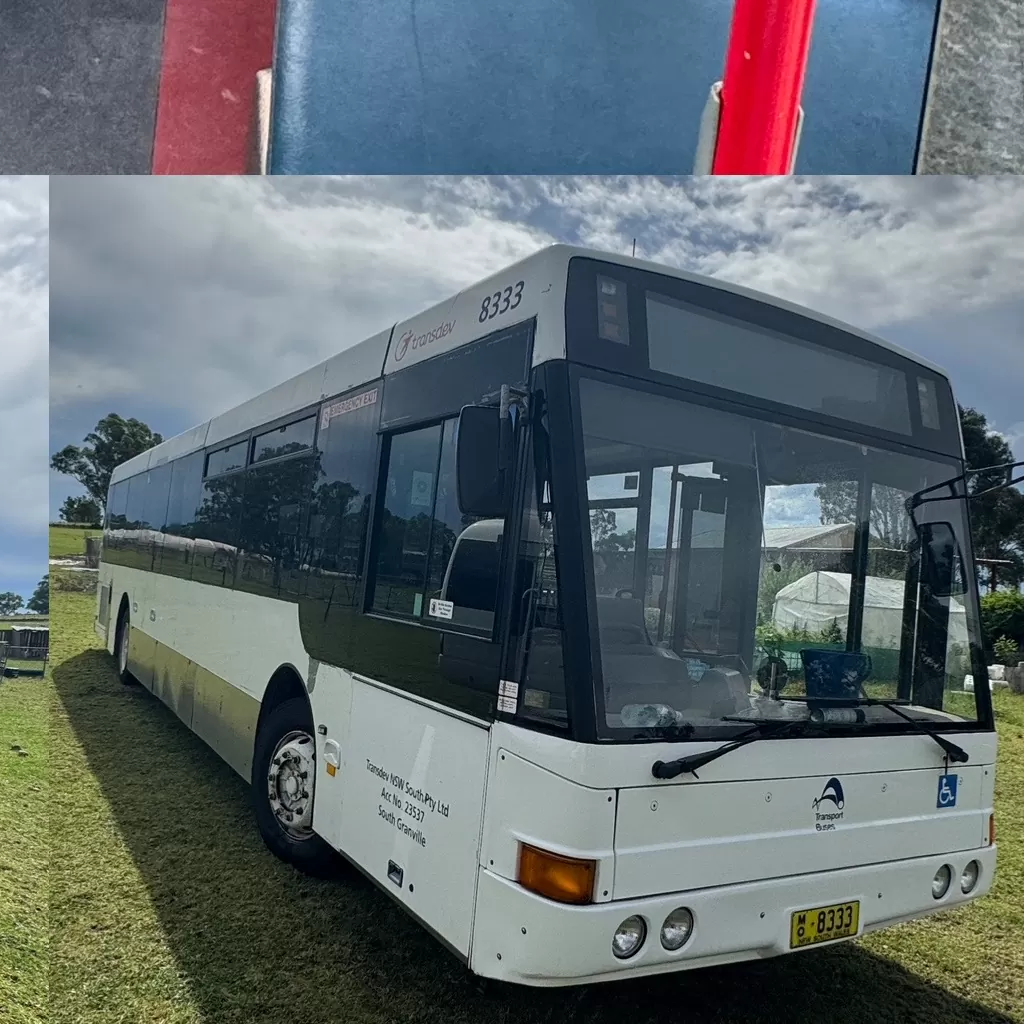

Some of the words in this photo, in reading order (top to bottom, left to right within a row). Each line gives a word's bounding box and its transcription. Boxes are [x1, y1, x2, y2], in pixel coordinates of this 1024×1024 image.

[478, 280, 525, 324] 8333
[411, 319, 457, 351] transdev
[363, 389, 378, 405] EXIT
[366, 758, 390, 782] Transdev
[390, 772, 405, 791] NSW
[405, 781, 424, 804] South
[424, 792, 437, 813] Pty
[437, 799, 450, 818] Ltd
[380, 787, 392, 803] Acc
[392, 793, 404, 811] No.
[404, 800, 425, 823] 23537
[378, 804, 396, 827] South
[396, 817, 426, 848] Granville
[815, 811, 844, 822] Transport
[817, 905, 853, 934] 8333
